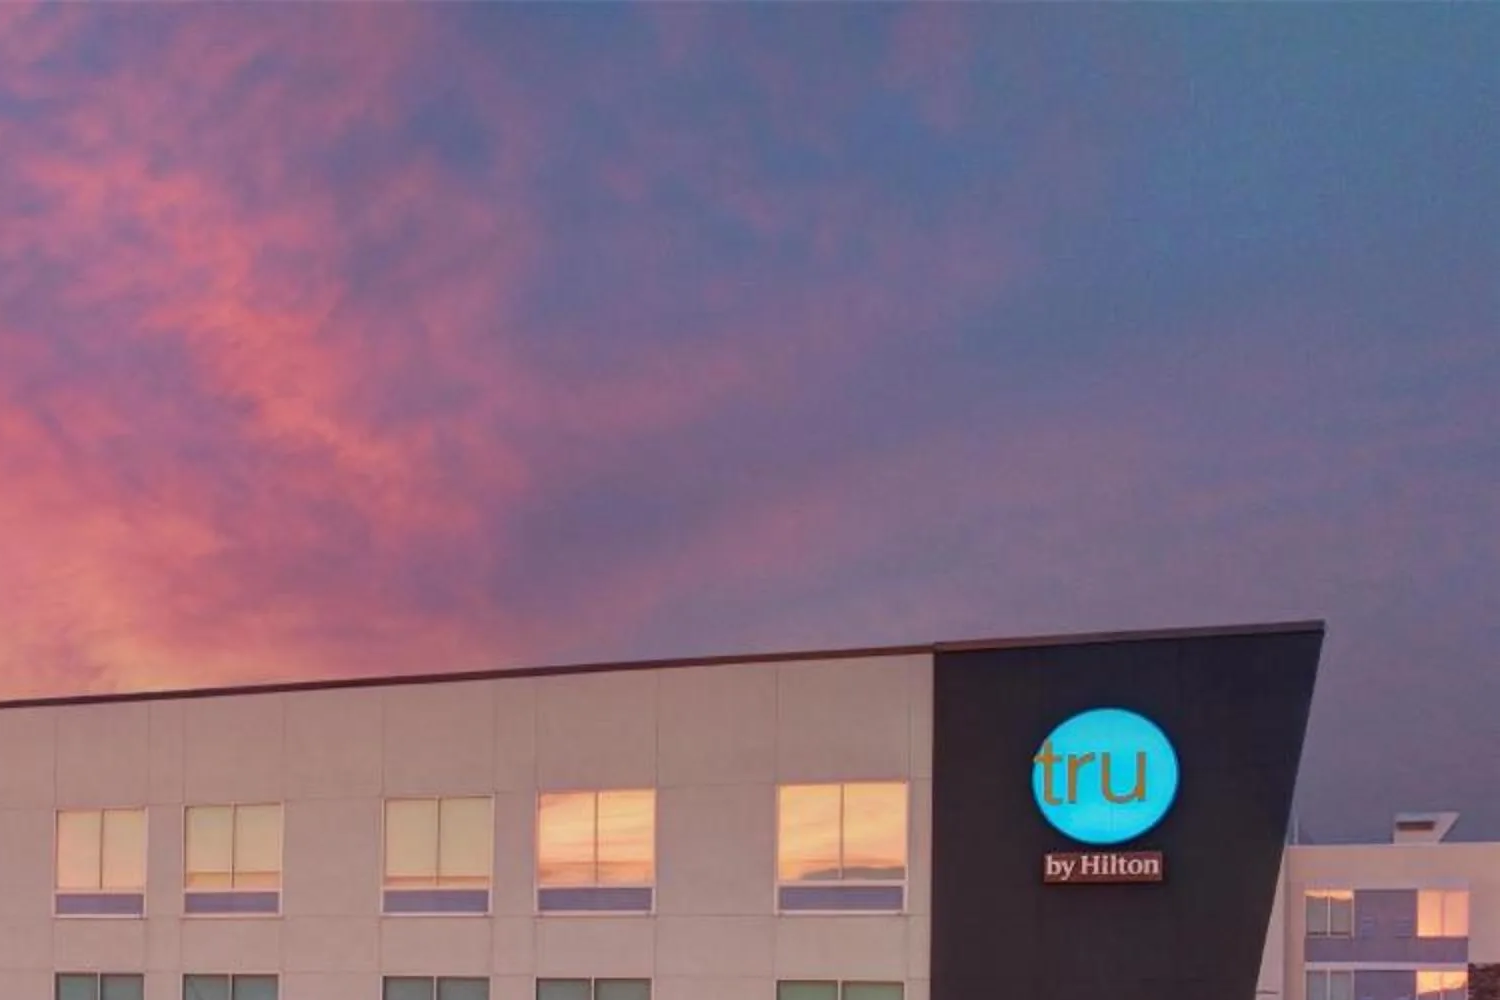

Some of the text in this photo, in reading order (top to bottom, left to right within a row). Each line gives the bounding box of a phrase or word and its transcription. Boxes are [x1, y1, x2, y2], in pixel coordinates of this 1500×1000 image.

[1033, 739, 1146, 806] tru
[1046, 854, 1160, 881] by Hilton
